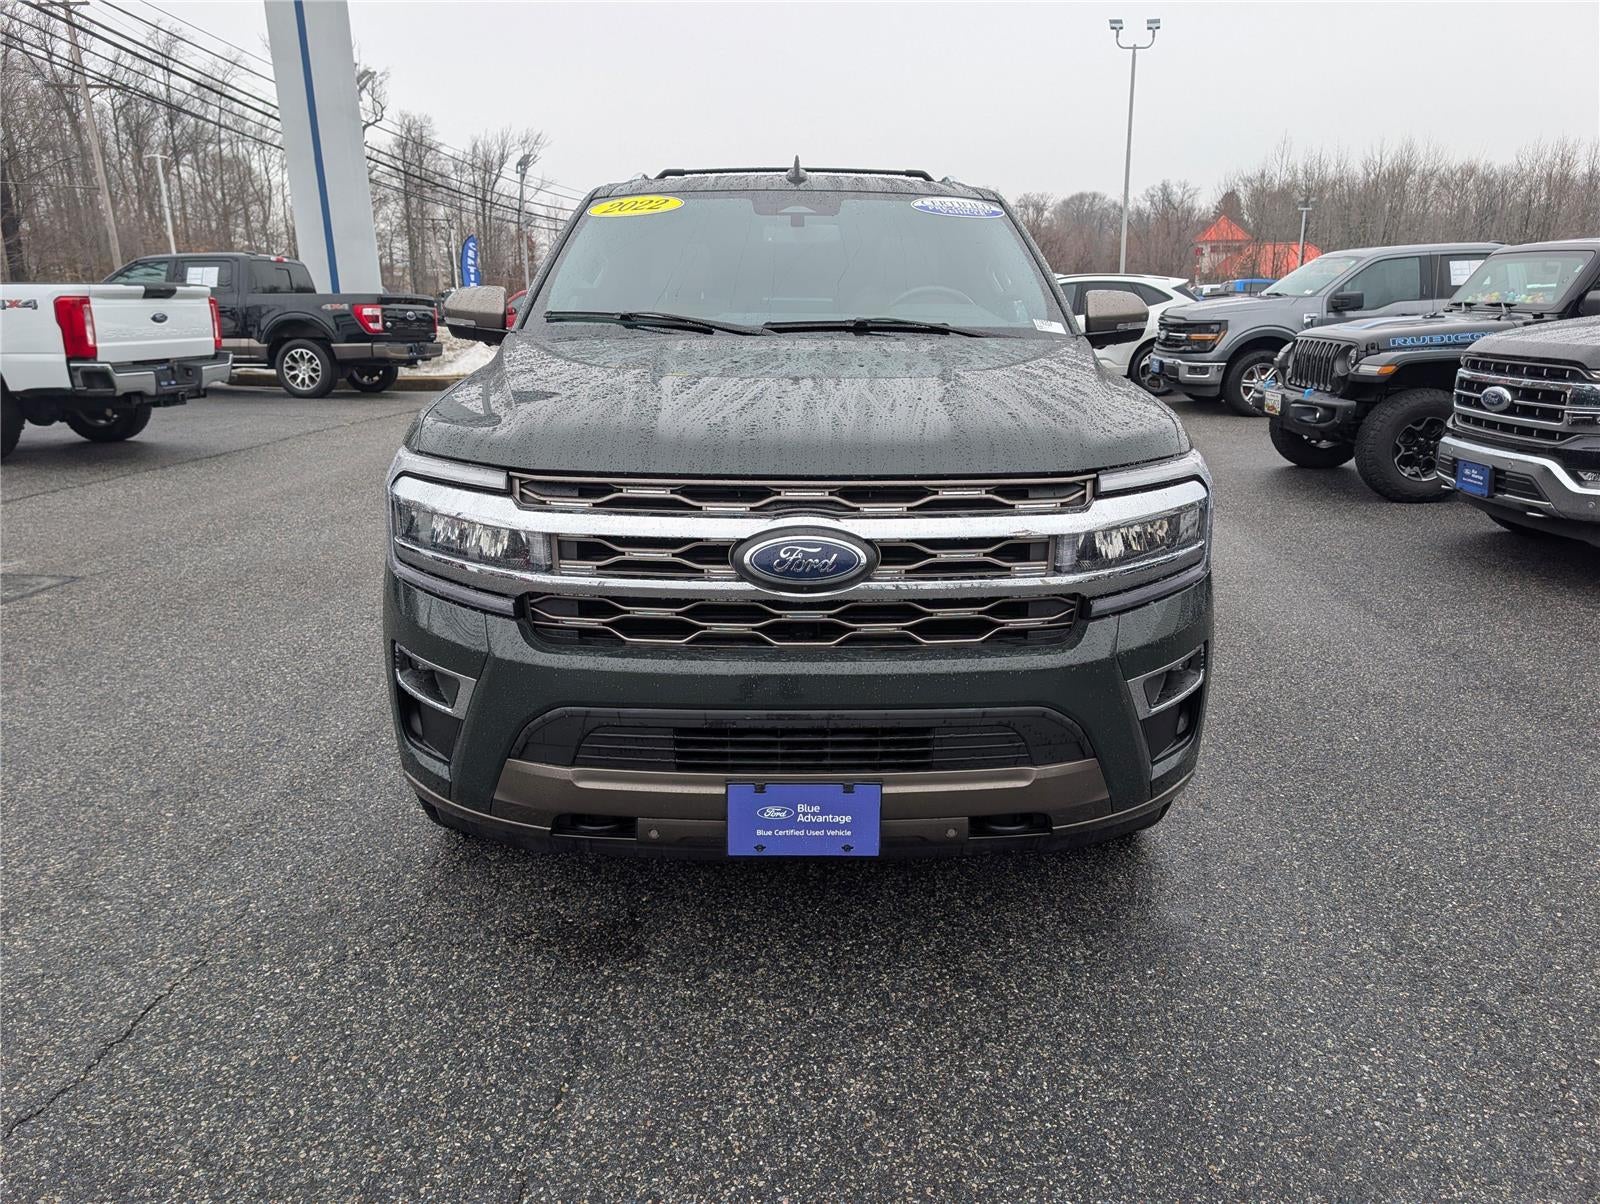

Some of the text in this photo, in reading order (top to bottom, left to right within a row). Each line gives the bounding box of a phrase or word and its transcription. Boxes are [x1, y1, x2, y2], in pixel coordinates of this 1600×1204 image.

[601, 199, 669, 214] 2022
[1390, 331, 1496, 347] RUBICO
[773, 546, 838, 573] Ford
[763, 808, 788, 818] Ford
[797, 804, 820, 813] Blue
[797, 813, 852, 824] Advantage
